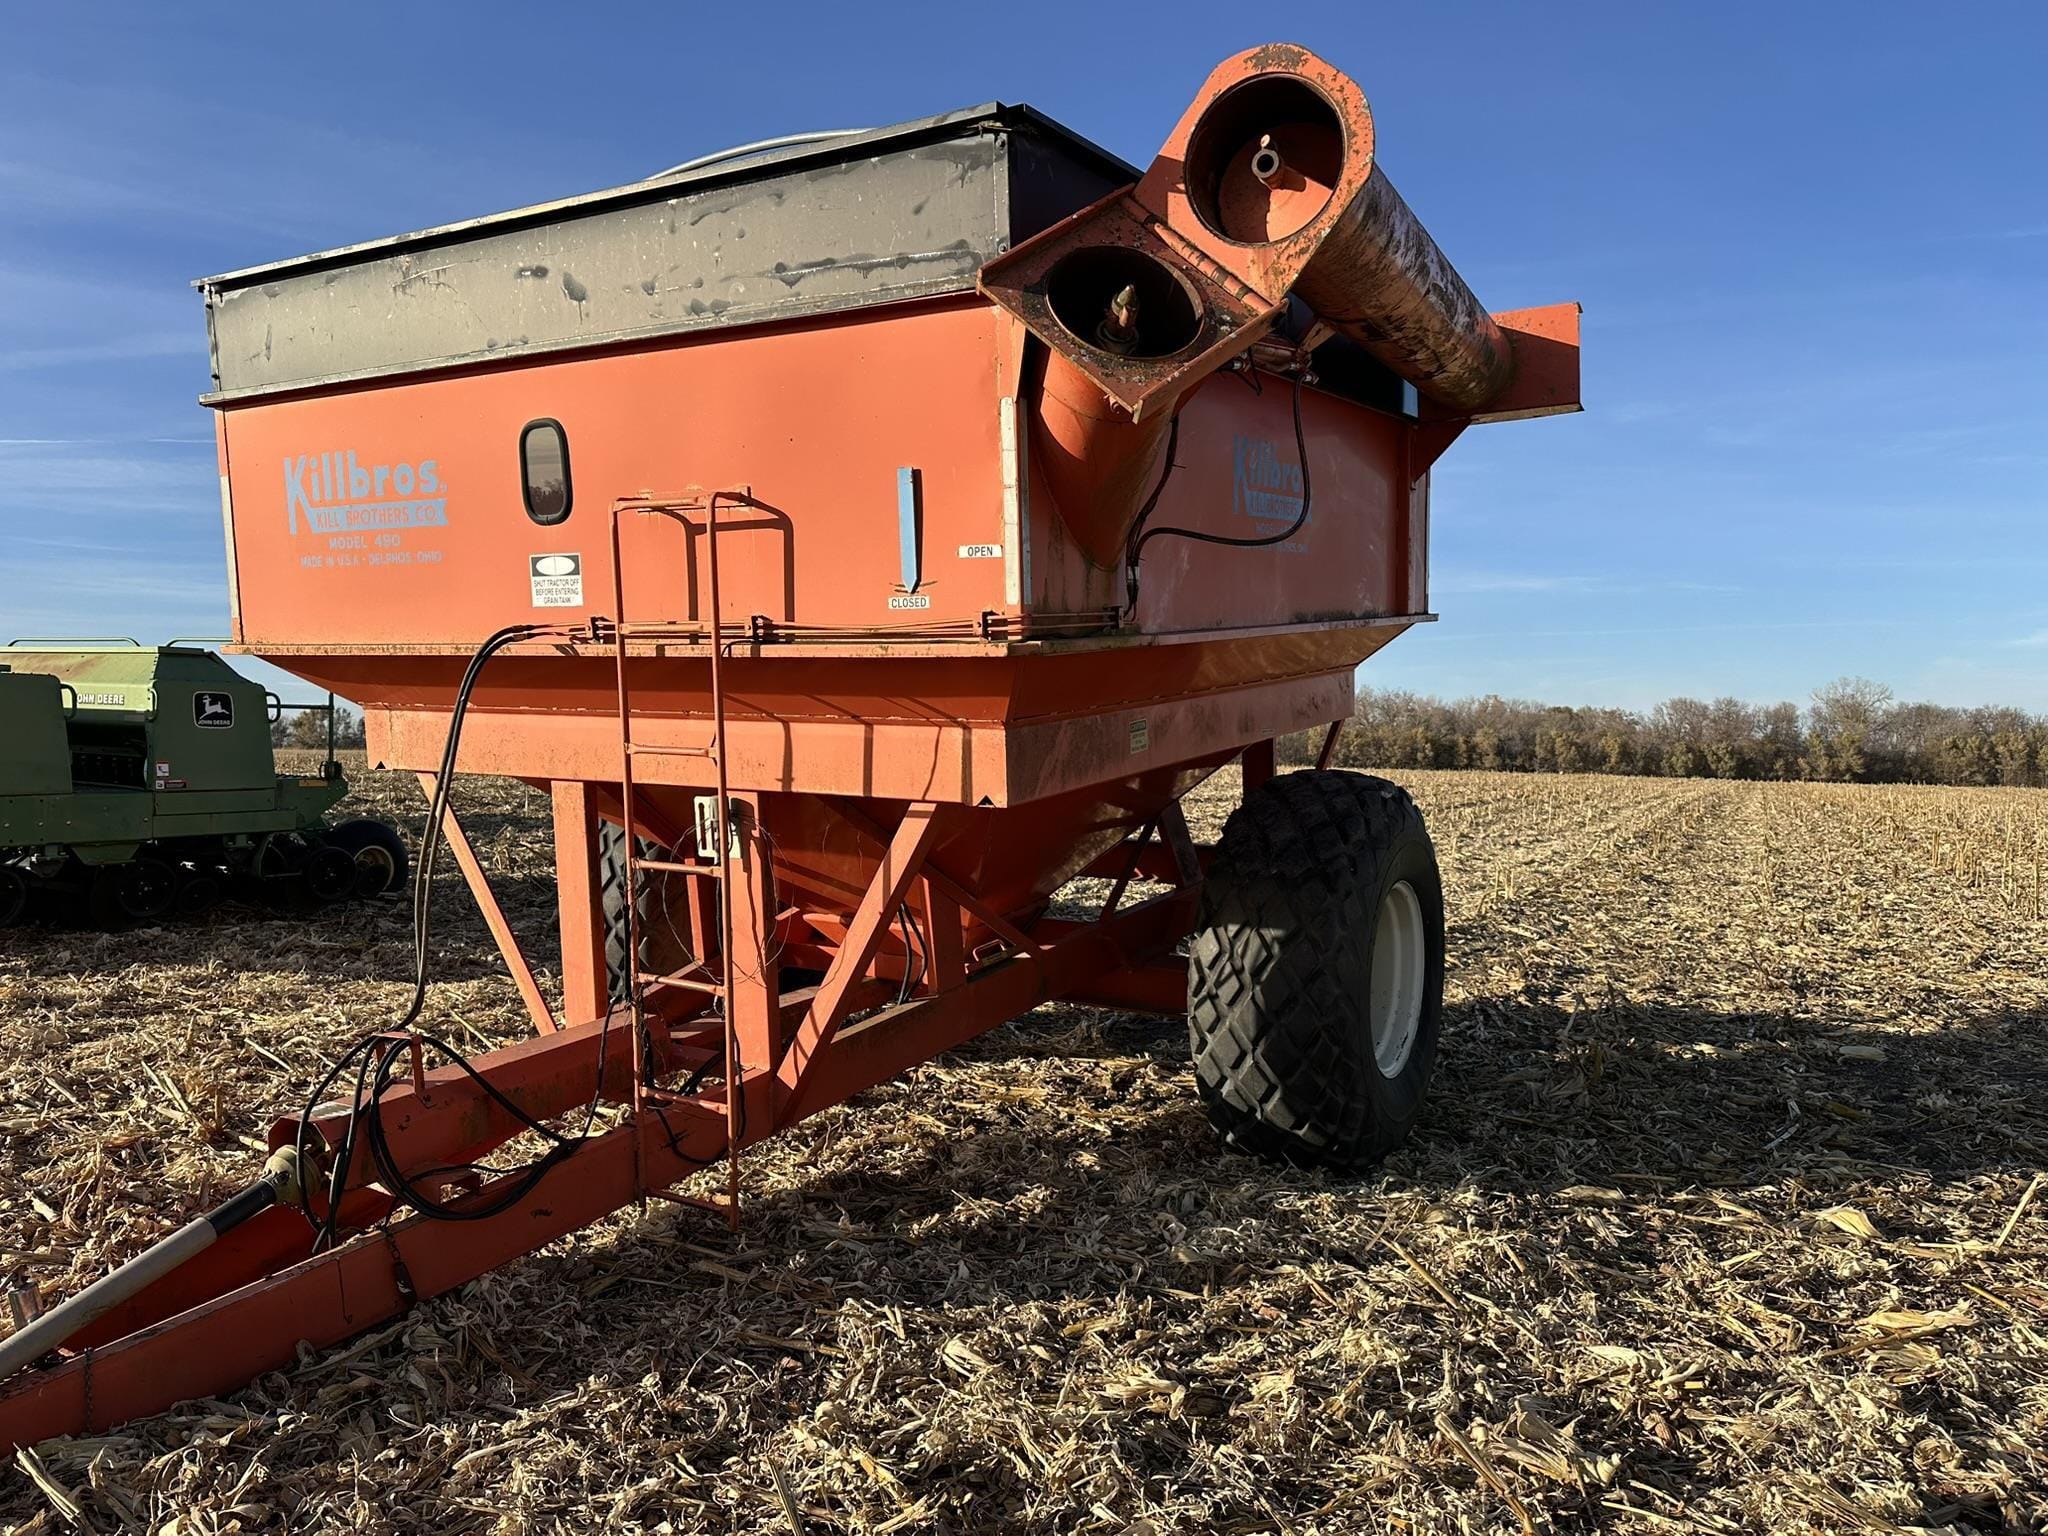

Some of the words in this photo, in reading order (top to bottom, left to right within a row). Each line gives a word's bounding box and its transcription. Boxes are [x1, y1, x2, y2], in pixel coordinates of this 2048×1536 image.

[1233, 431, 1303, 514] Killbro
[284, 449, 438, 536] Killbros
[346, 507, 409, 526] BROTHERS
[329, 536, 368, 550] MODEL
[301, 555, 322, 567] MADE
[416, 551, 443, 564] OHIO
[967, 546, 993, 557] OPEN
[891, 597, 927, 609] CLOSED
[77, 693, 95, 705] OHN
[98, 694, 125, 706] DEERE
